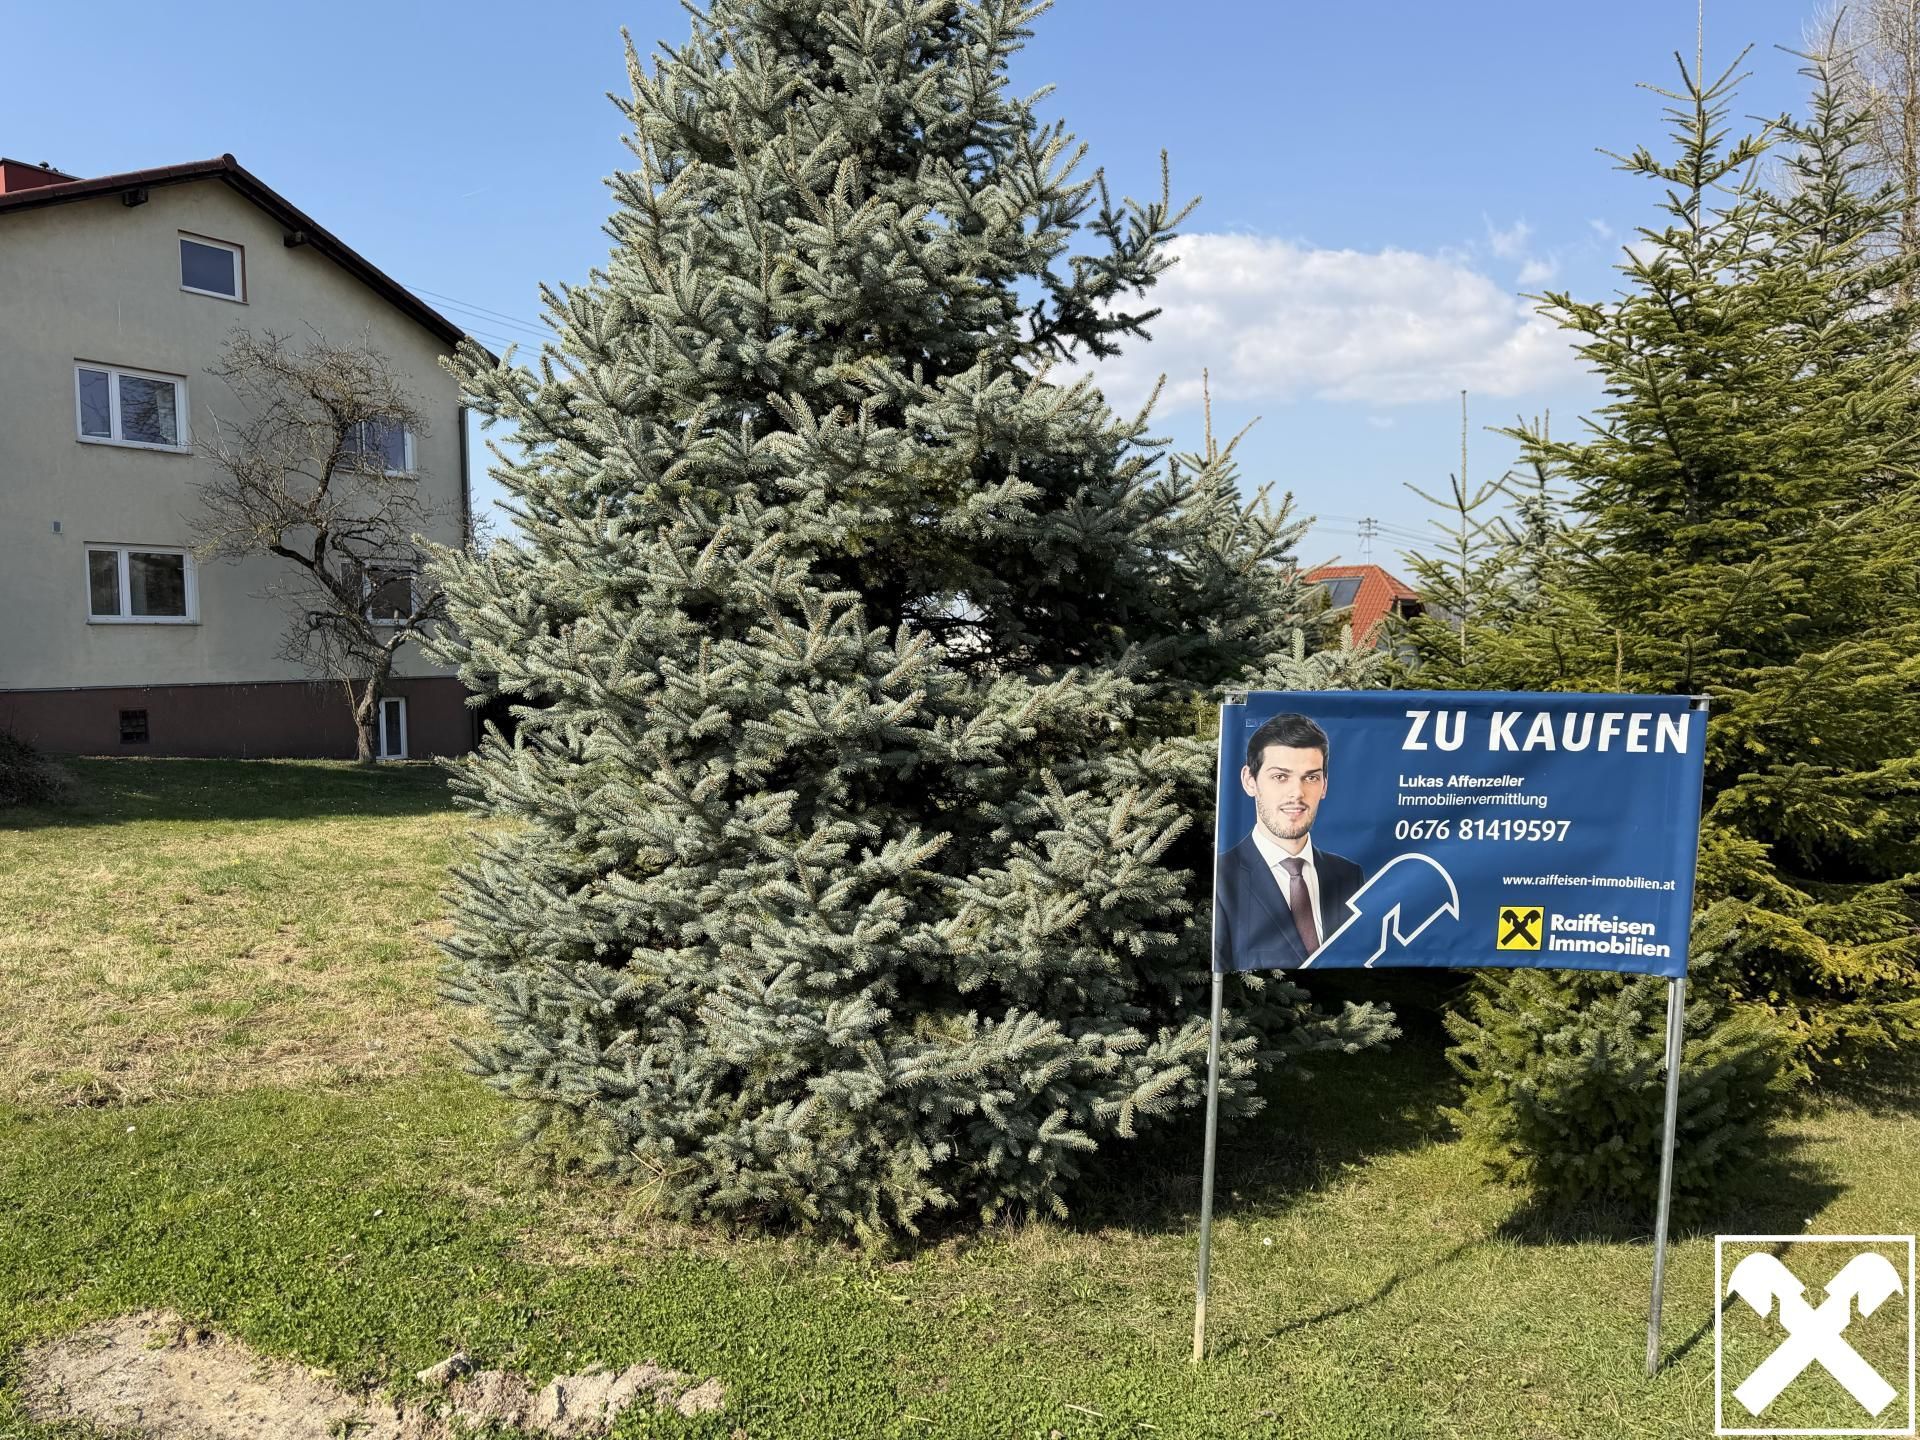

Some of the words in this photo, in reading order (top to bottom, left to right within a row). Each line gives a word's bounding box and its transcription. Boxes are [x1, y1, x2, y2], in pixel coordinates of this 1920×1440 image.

[1401, 710, 1467, 752] ZU
[1488, 711, 1691, 754] KAUFEN
[1399, 774, 1444, 788] Lukas
[1446, 774, 1525, 788] Affenzeller
[1398, 792, 1548, 809] Immobilienvermittlung
[1395, 819, 1450, 840] 0676
[1458, 818, 1572, 842] 81419597
[1502, 874, 1676, 891] www.raiffeisen-immobilien.at
[1550, 913, 1656, 936] Raiffeisen
[1548, 934, 1671, 958] Immobilien
